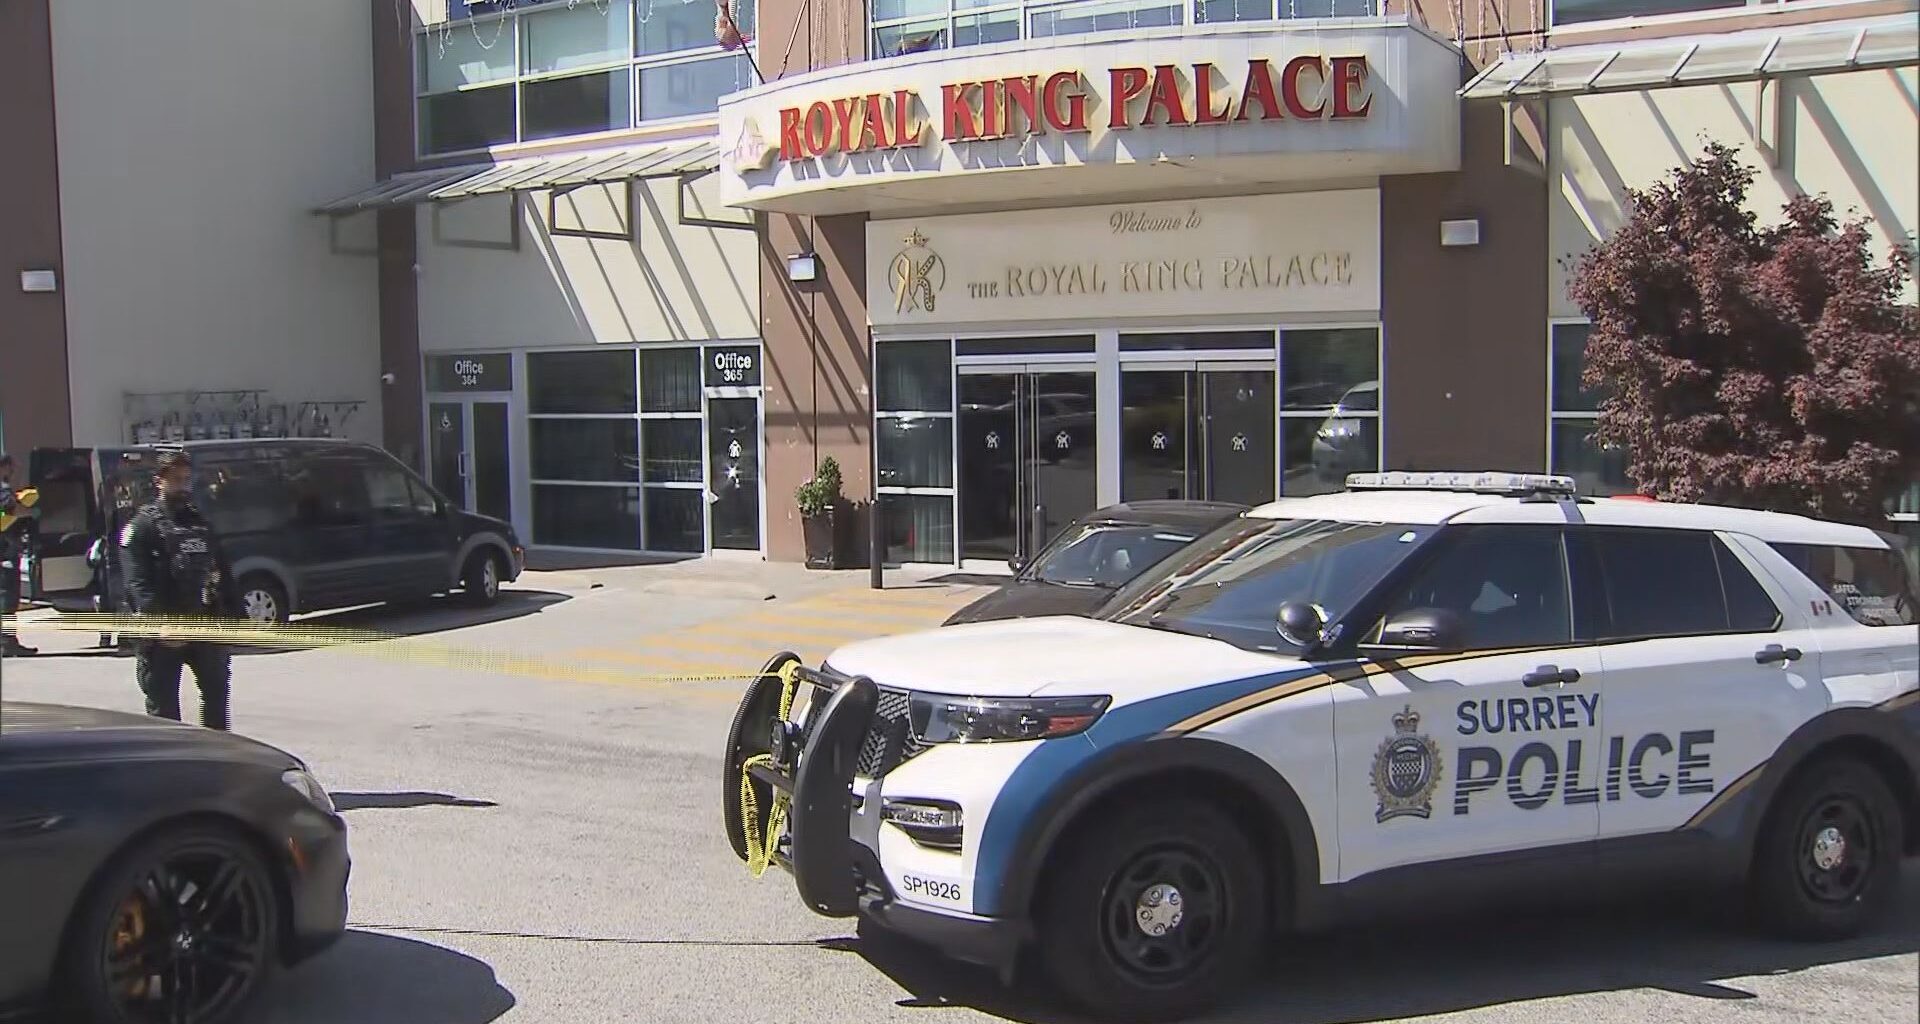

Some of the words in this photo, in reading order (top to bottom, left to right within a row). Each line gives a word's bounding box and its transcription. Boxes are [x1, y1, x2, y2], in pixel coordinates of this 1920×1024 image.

[779, 90, 922, 161] ROYAL
[940, 70, 1092, 143] KING
[1107, 55, 1373, 130] PALACE
[1110, 210, 1181, 234] Welcome
[1185, 208, 1202, 229] to
[967, 281, 999, 299] THE
[1006, 264, 1106, 298] ROYAL
[1120, 259, 1203, 292] KING
[1222, 252, 1353, 289] PALACE
[454, 360, 484, 375] Office
[714, 352, 752, 370] Office
[723, 369, 743, 382] 365
[1456, 693, 1600, 736] SURREY
[1453, 729, 1716, 815] POLICE
[903, 874, 961, 901] SP1926
